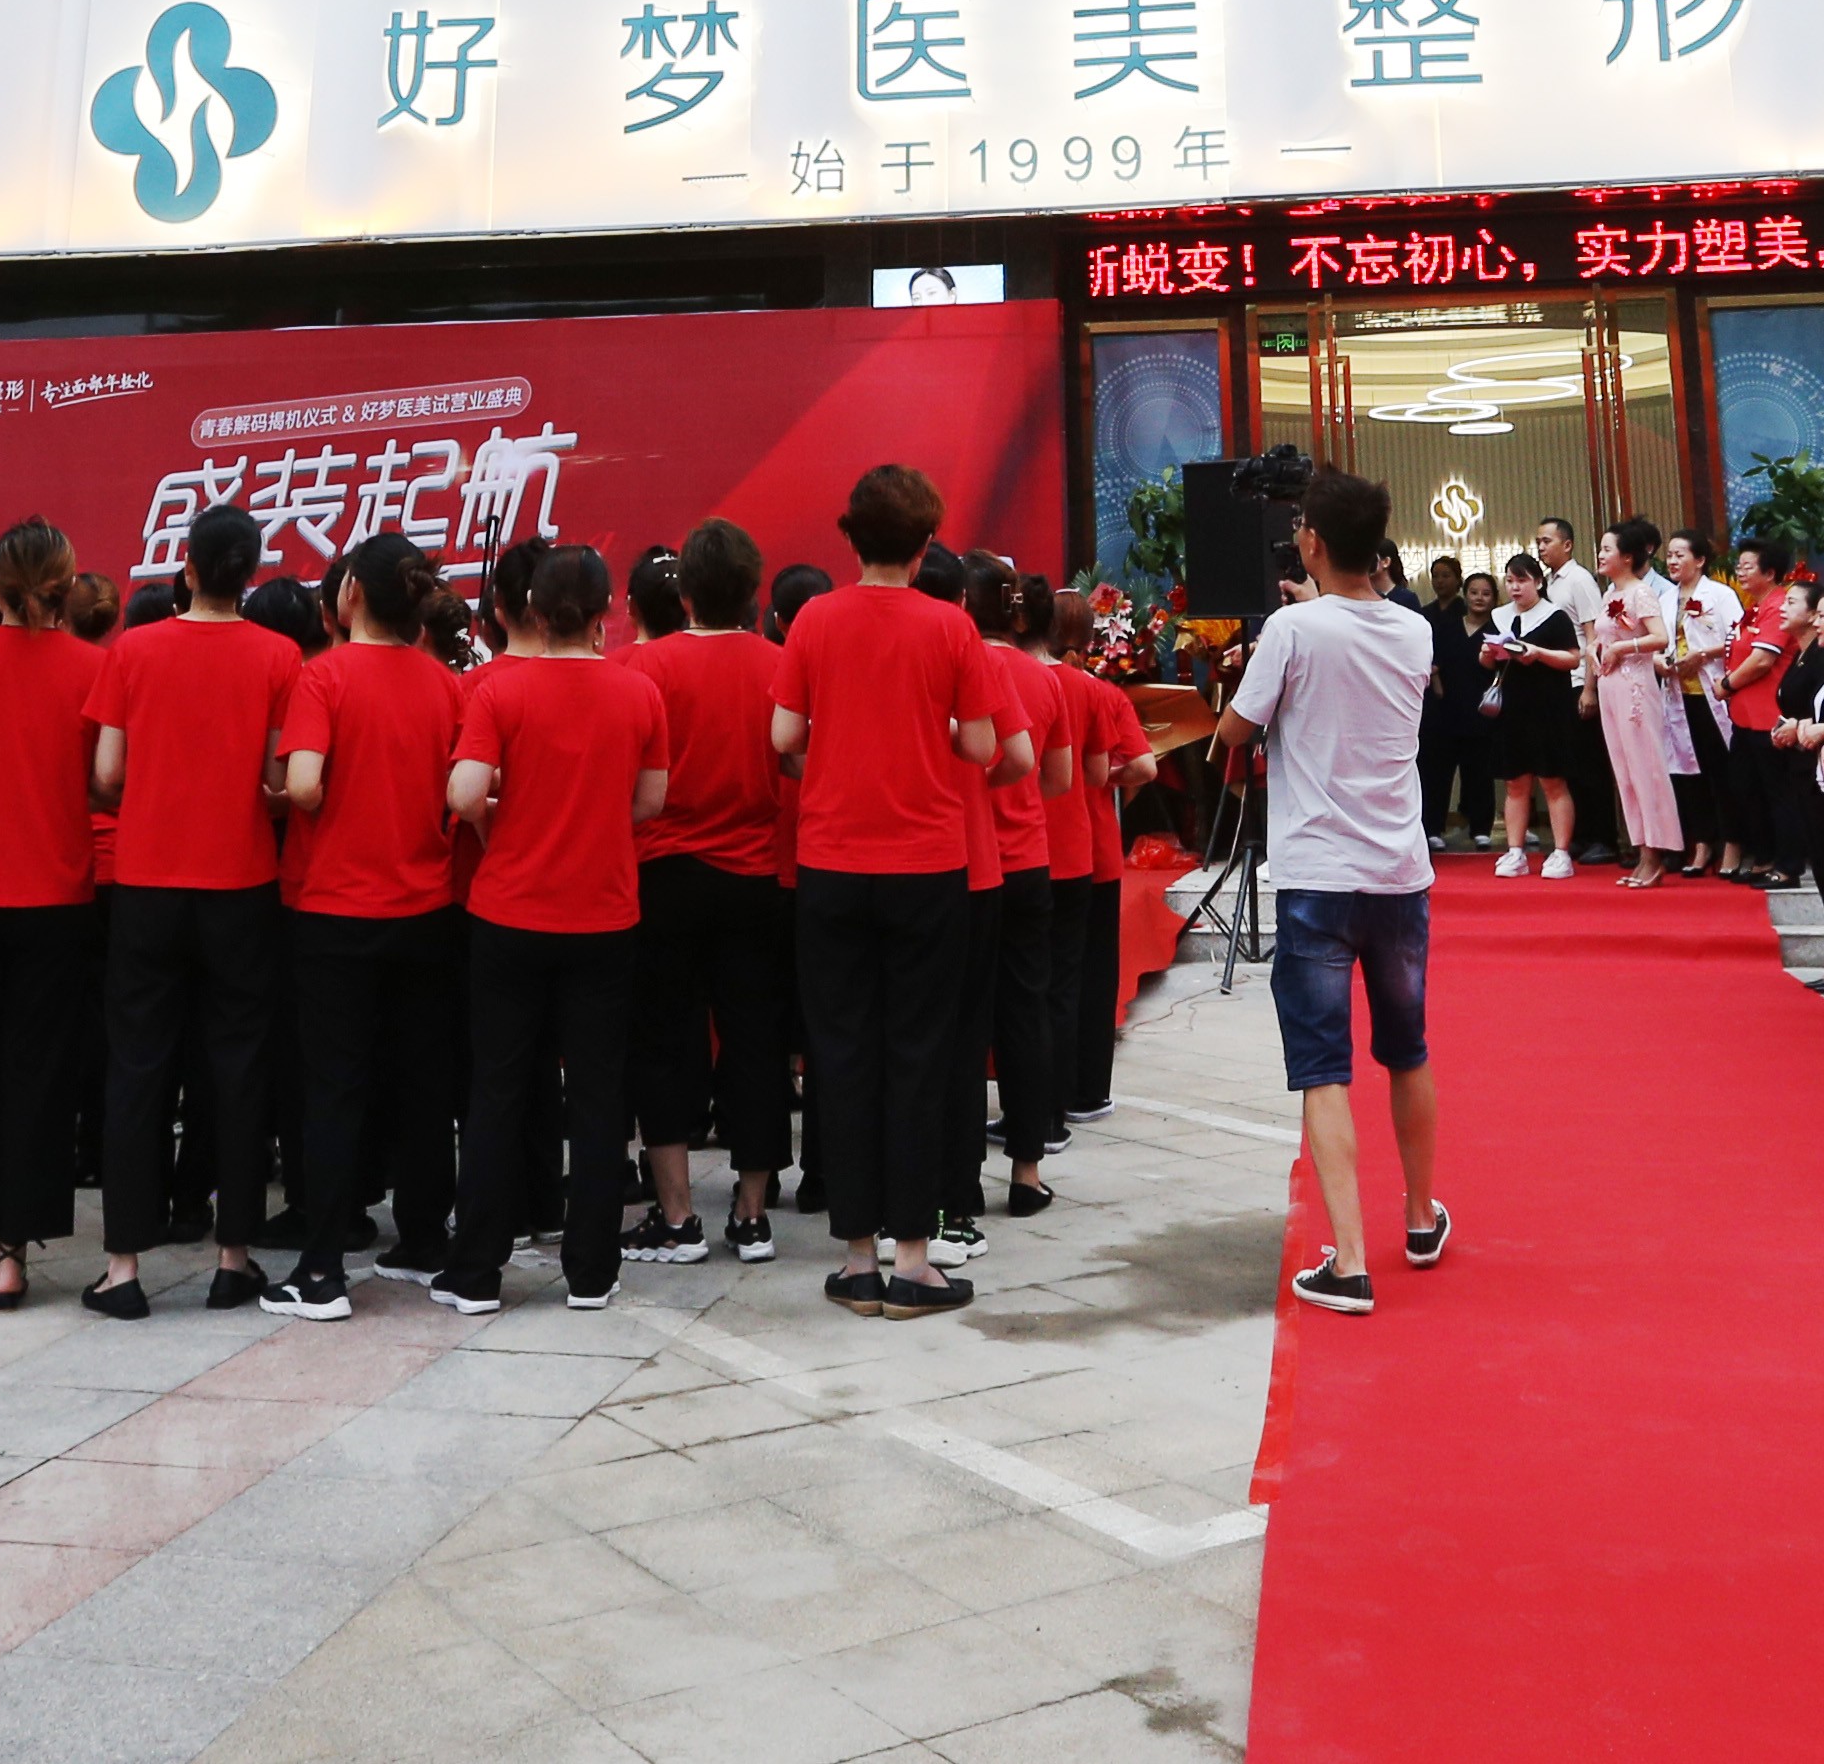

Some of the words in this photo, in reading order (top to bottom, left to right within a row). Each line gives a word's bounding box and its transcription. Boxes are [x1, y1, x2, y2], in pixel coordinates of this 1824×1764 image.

[39, 370, 154, 404] 专注面部年轻化
[198, 404, 338, 440] 青春解码揭机仪式
[360, 385, 524, 422] 好梦医美试营业盛典
[129, 421, 579, 582] 盛装起航
